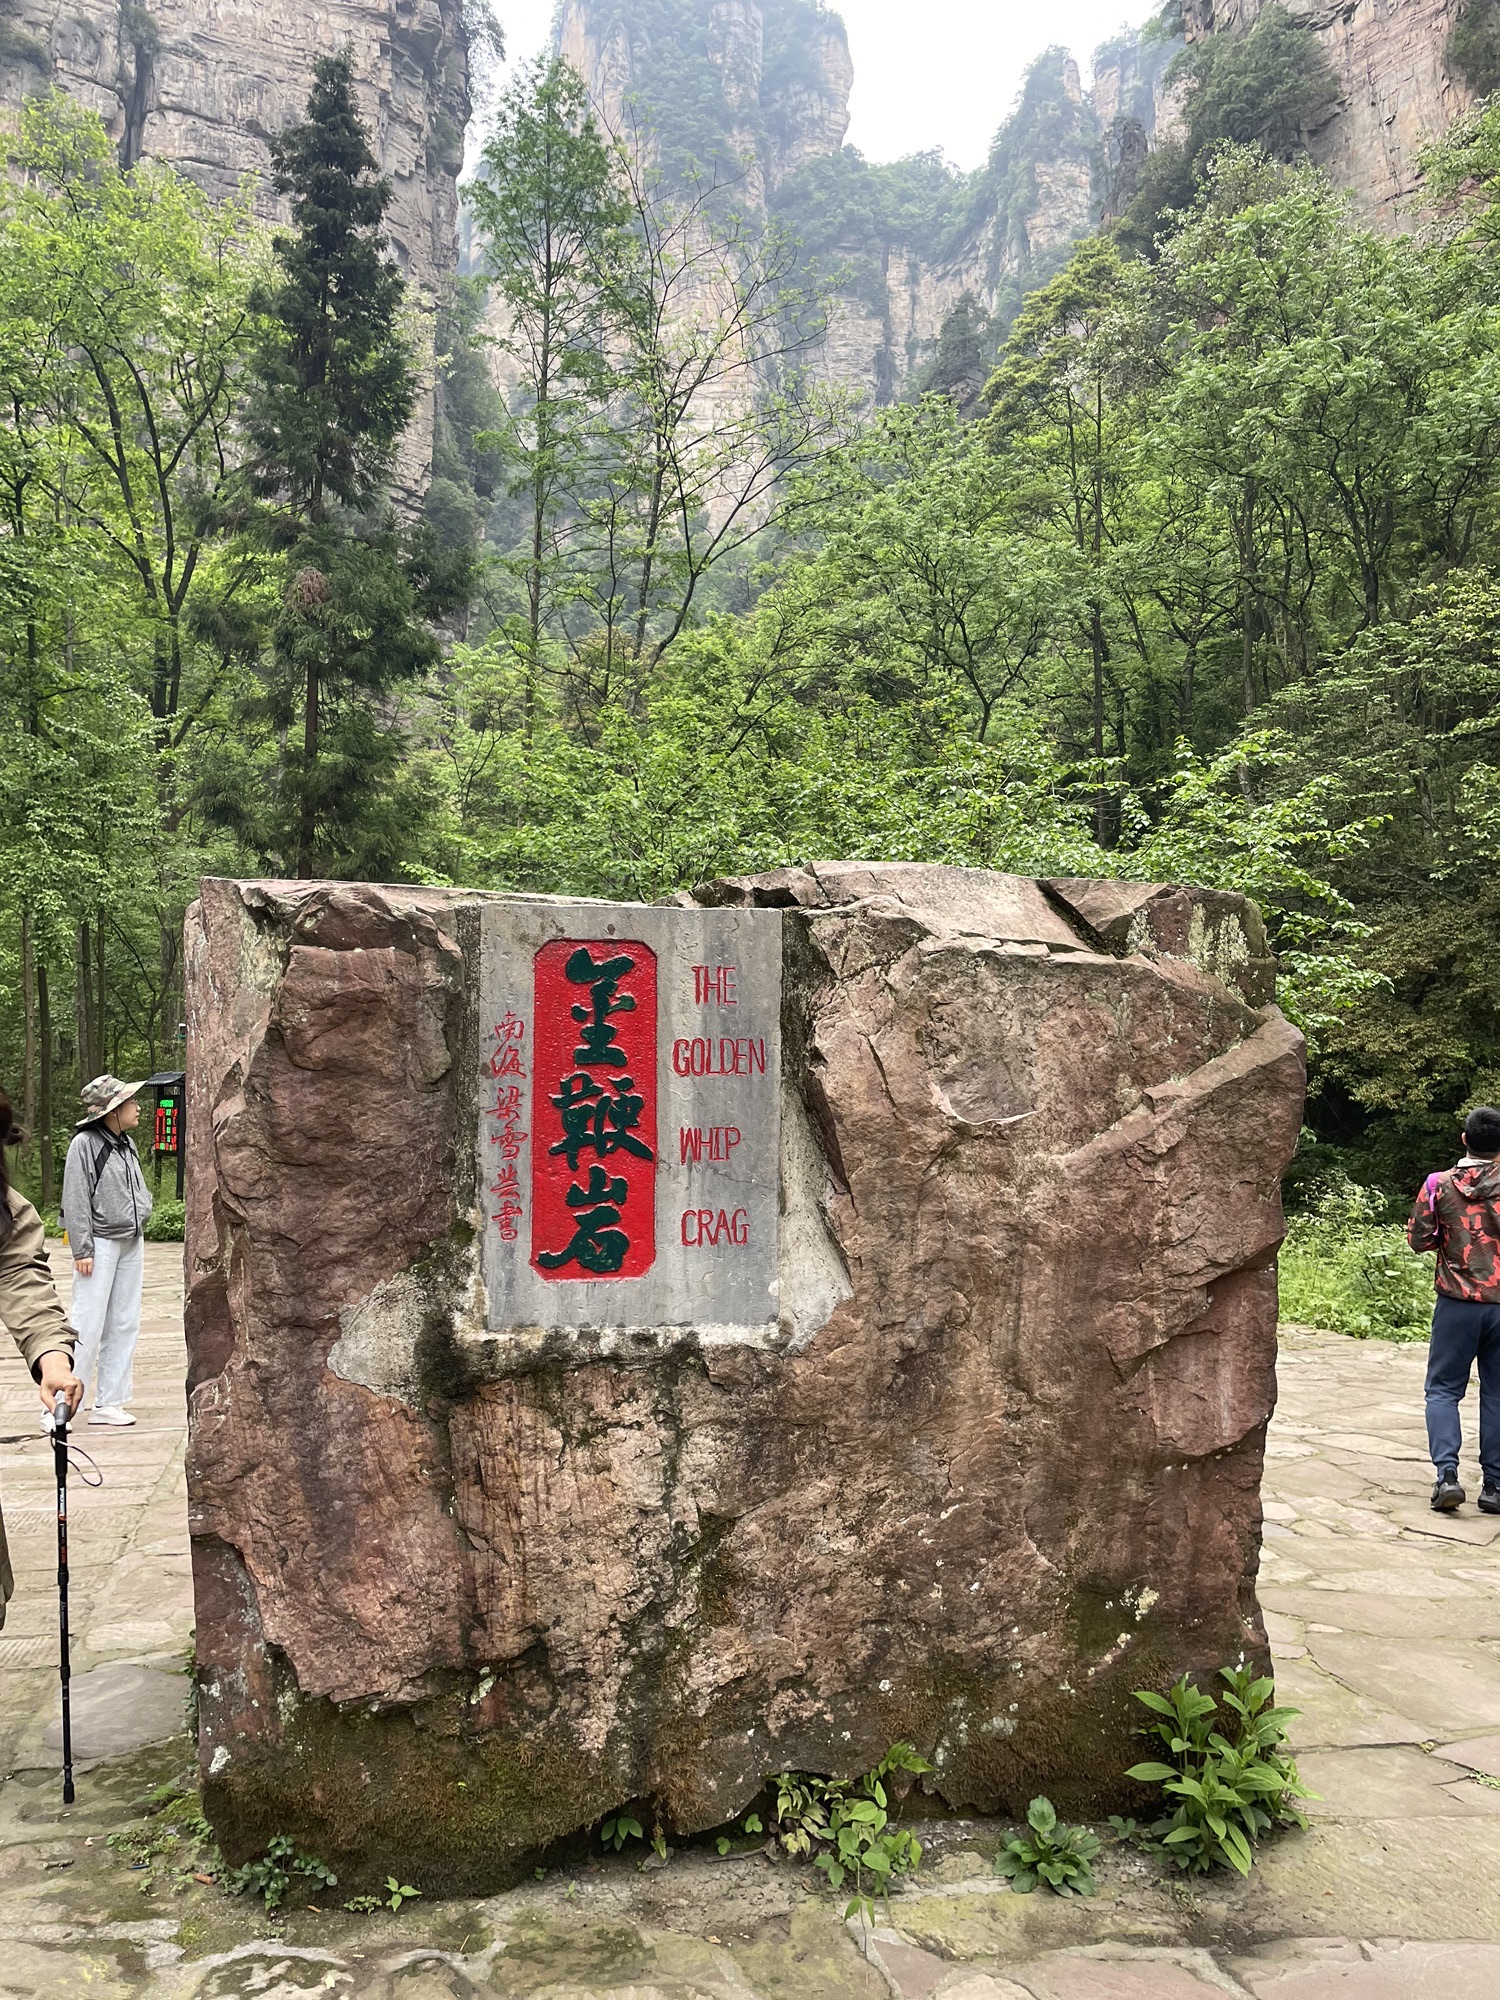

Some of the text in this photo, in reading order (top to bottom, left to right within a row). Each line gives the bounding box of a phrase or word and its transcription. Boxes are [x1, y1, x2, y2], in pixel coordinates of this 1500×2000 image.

[691, 965, 737, 1006] THE
[673, 1038, 765, 1076] GOLDEN
[537, 947, 654, 1272] 金鞭岩
[680, 1127, 741, 1165] WHIP
[681, 1208, 750, 1247] CRAG
